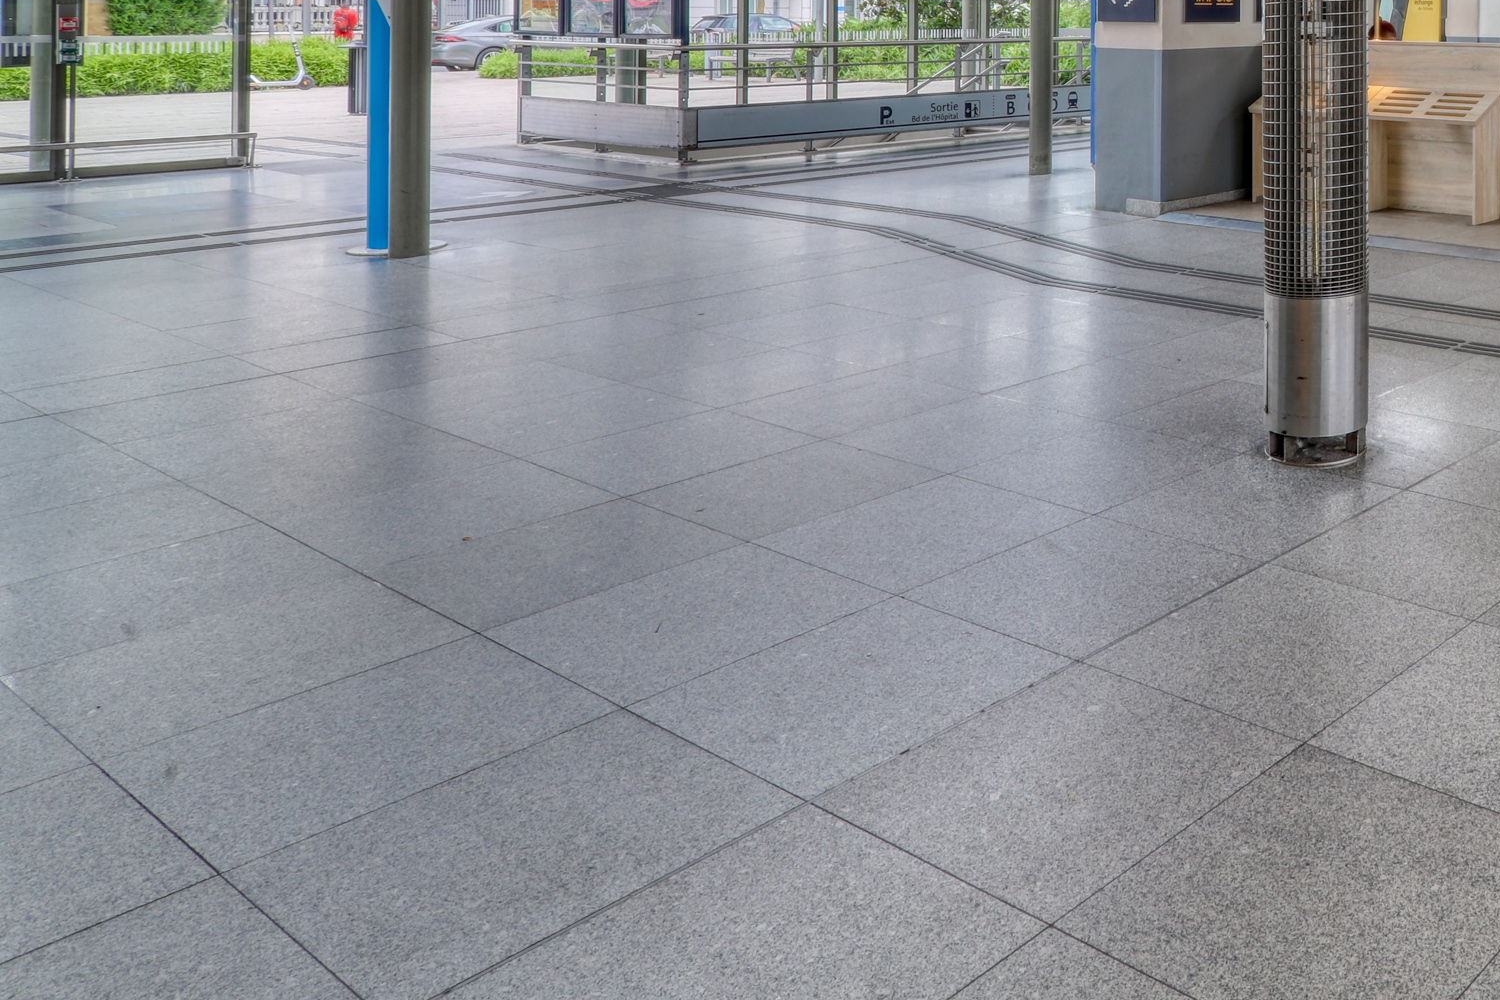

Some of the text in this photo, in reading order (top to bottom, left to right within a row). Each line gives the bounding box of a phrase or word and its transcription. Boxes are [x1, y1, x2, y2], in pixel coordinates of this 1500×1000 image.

[930, 102, 959, 112] Sortie
[1007, 101, 1015, 115] B
[880, 106, 892, 125] P
[932, 112, 959, 122] l'Hôpital
